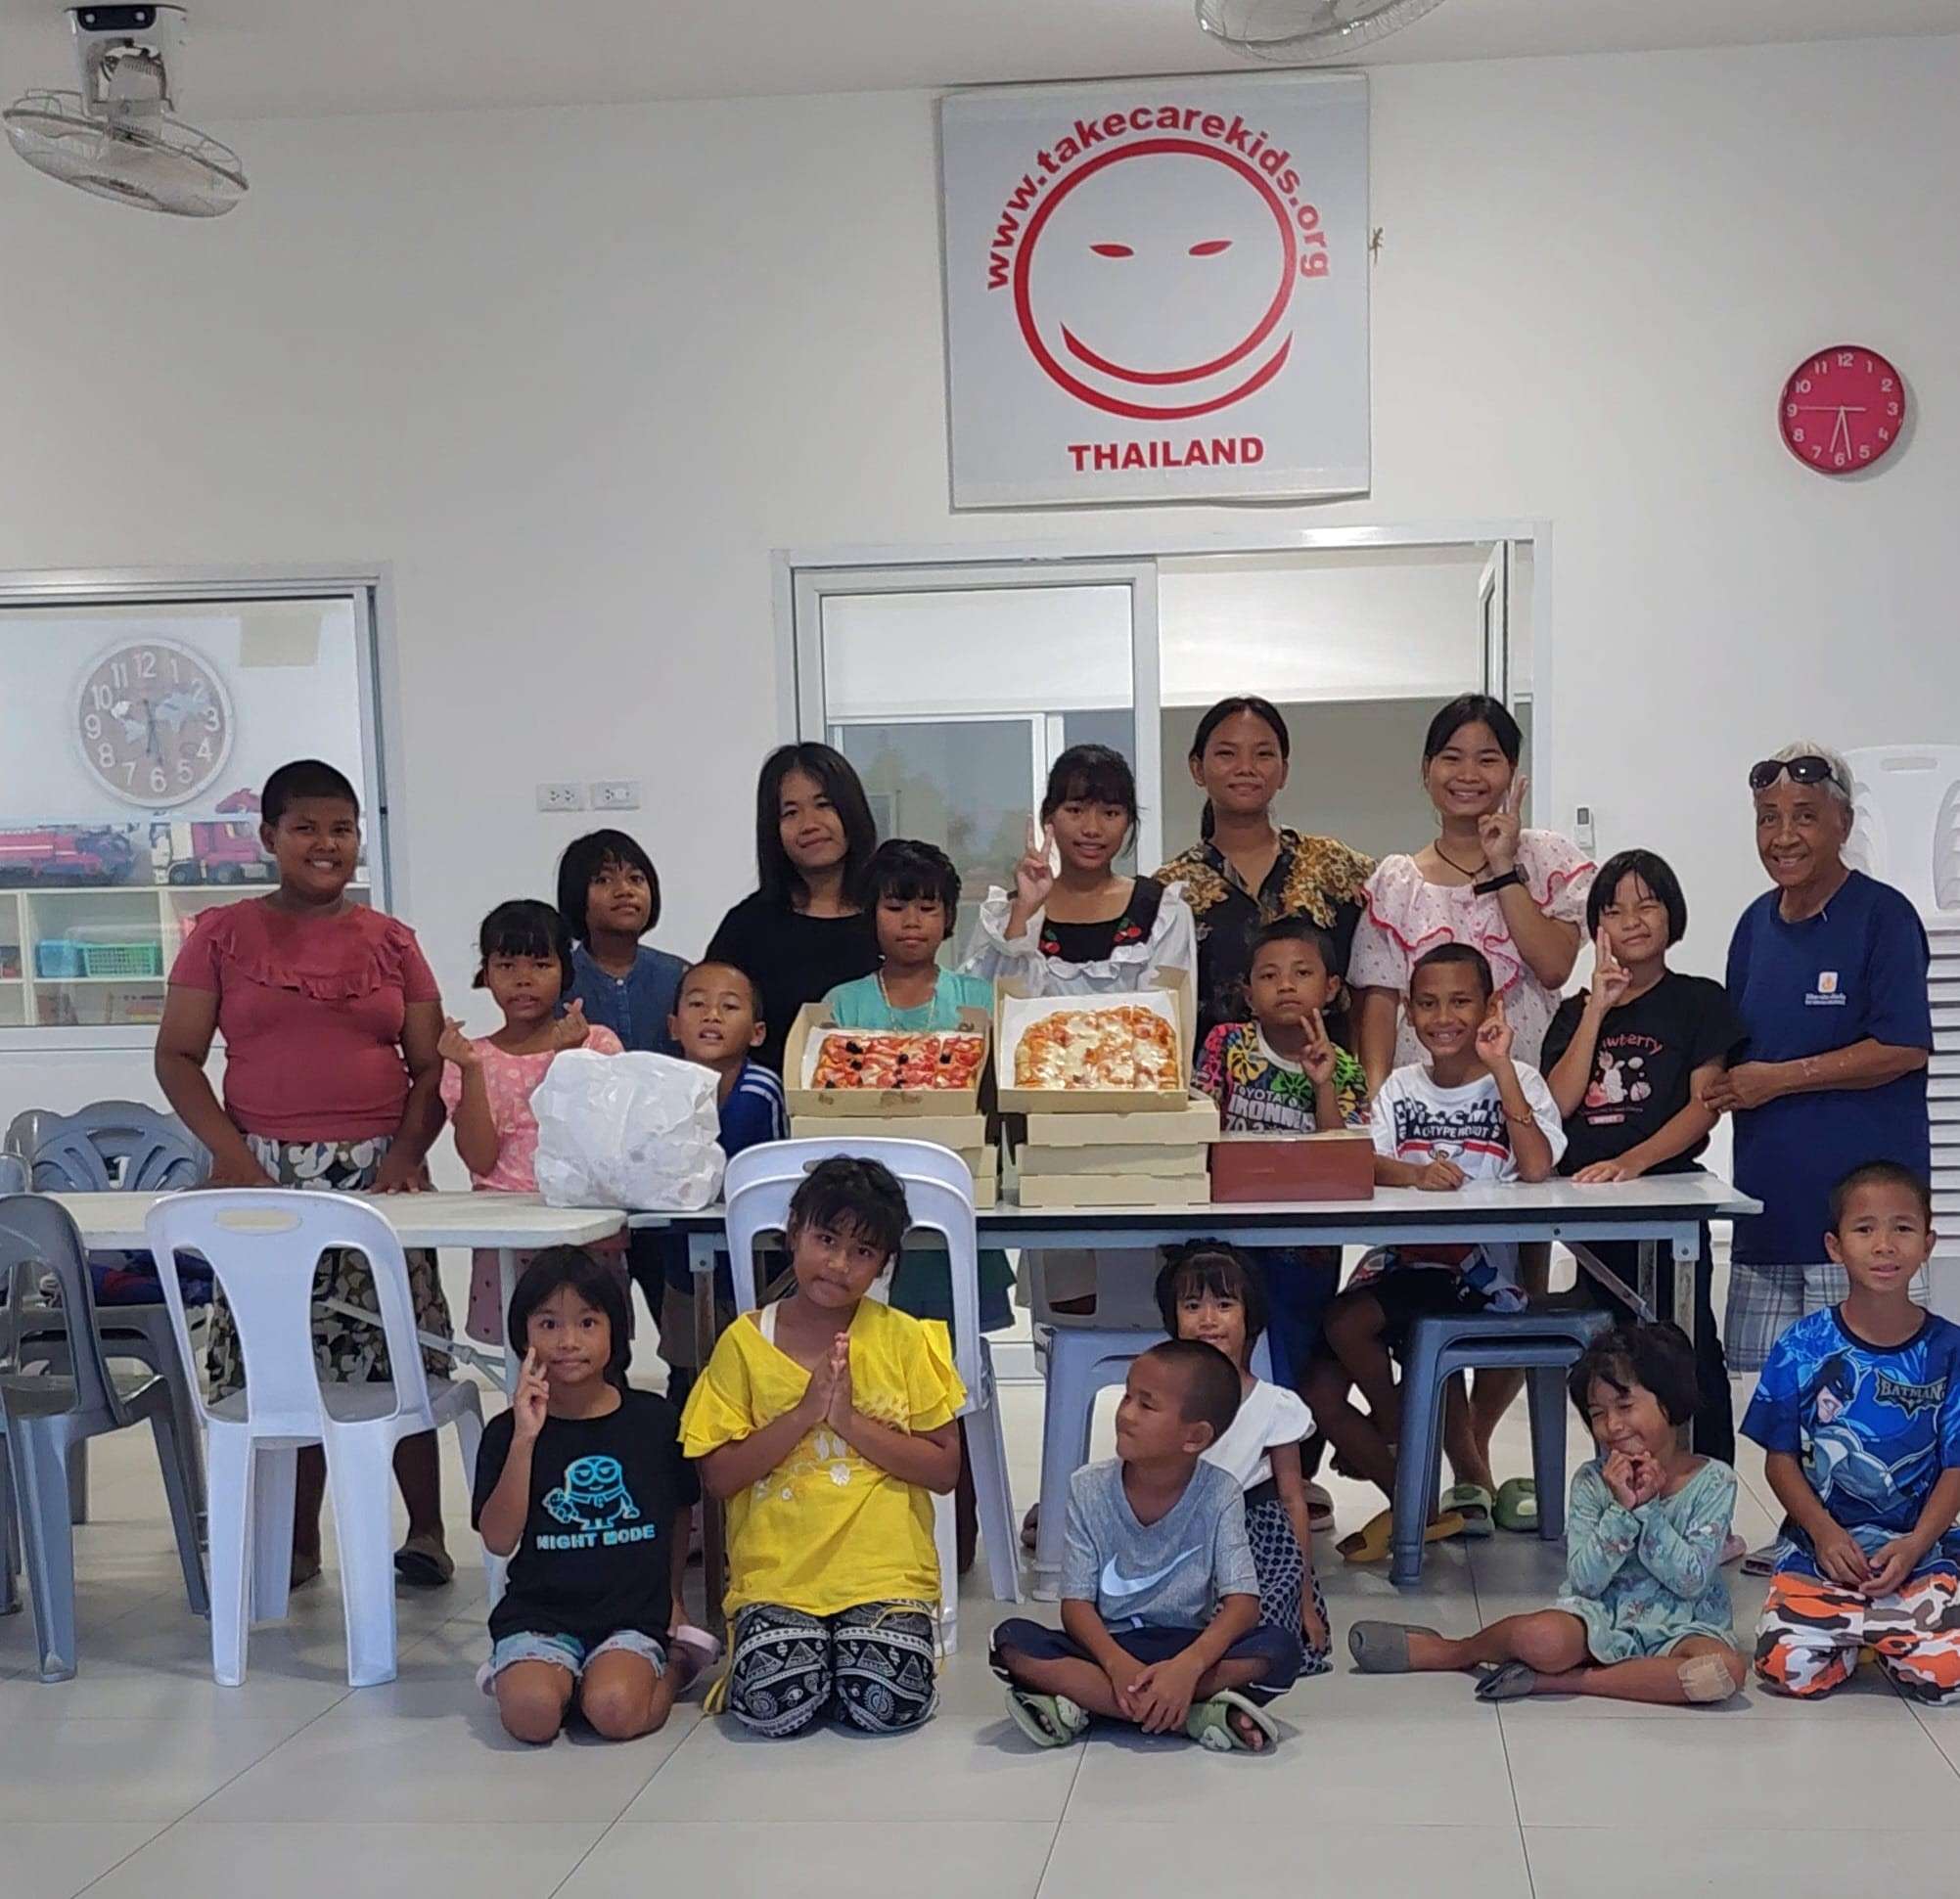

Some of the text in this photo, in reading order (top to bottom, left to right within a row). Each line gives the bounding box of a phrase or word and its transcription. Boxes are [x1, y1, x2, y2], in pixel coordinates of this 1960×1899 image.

[987, 106, 1329, 291] www.takecarekids.org
[1814, 360, 1827, 374] 11
[1837, 352, 1853, 367] 12
[1867, 360, 1874, 373] 1
[1795, 380, 1811, 393] 10
[1881, 378, 1892, 392] 2
[1787, 403, 1798, 418] 9
[1887, 402, 1898, 416] 3
[1793, 429, 1804, 441] 8
[1878, 428, 1889, 440] 4
[1068, 436, 1264, 472] THAILAND
[1811, 446, 1822, 459] 7
[1834, 453, 1845, 466] 6
[1859, 445, 1870, 459] 5
[111, 662, 128, 688] 11
[132, 652, 157, 678] 12
[170, 658, 179, 684] 1
[91, 684, 114, 710] 10
[84, 714, 101, 740] 9
[204, 707, 220, 732] 3
[99, 743, 115, 768] 8
[197, 737, 213, 762] 4
[121, 761, 137, 786] 7
[150, 767, 167, 792] 6
[178, 759, 194, 784] 5
[1233, 1081, 1282, 1103] TOYOTA
[1880, 1379, 1942, 1401] BATMAN
[536, 1524, 656, 1550] NIGHT MODE
